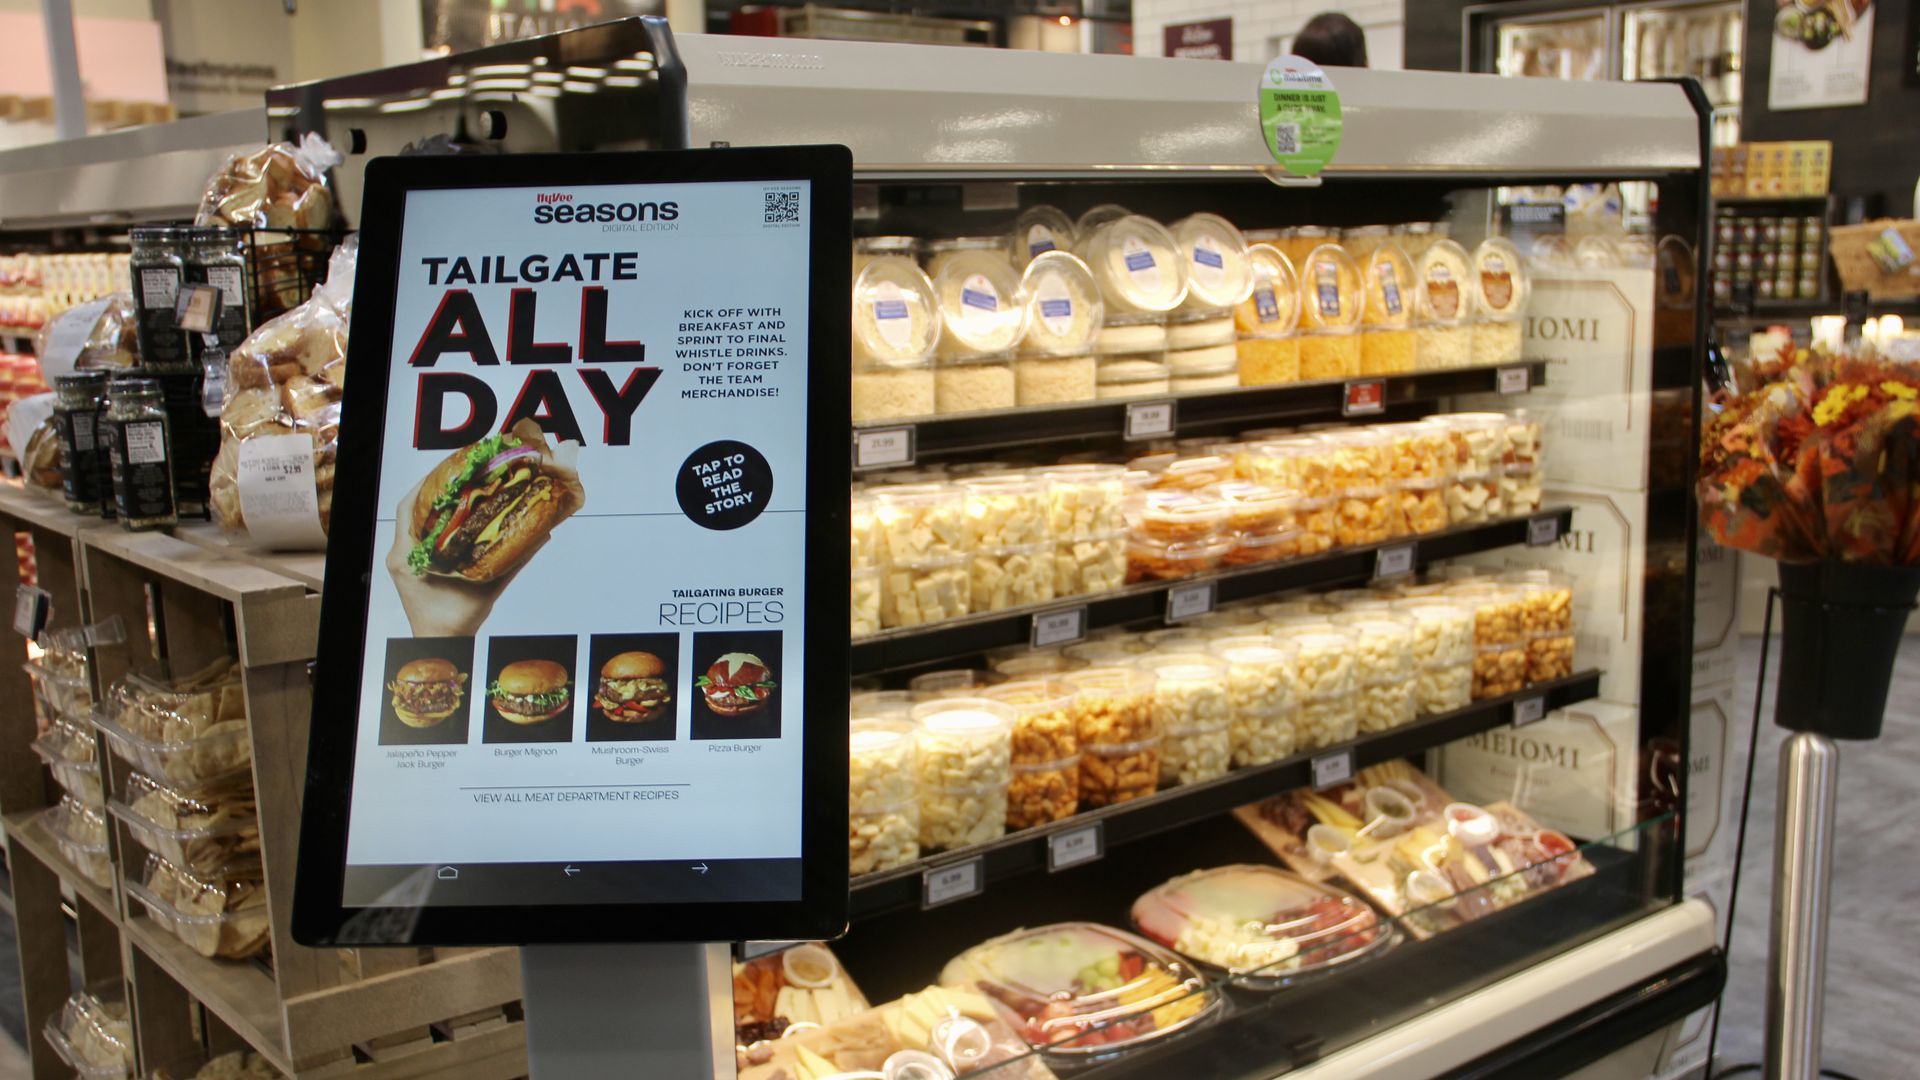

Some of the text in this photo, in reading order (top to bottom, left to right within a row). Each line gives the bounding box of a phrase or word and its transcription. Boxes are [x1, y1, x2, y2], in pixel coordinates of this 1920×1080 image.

[534, 201, 679, 224] seasons
[602, 223, 679, 233] DIGITAL EDITION
[421, 252, 638, 285] TAILGATE
[684, 308, 781, 318] KICK OFF WITH
[407, 286, 645, 367] ALL
[679, 321, 785, 332] BREAKFAST AND
[1527, 317, 1599, 341] IOMI
[678, 334, 786, 345] SPRINT TO FINAL
[676, 347, 788, 358] WHISTLE DRINKS.
[683, 361, 779, 372] DON'T FORGET
[699, 375, 763, 385] THE TEAM
[681, 388, 779, 399] MERCHANDISE!
[413, 367, 663, 450] DAY
[692, 453, 745, 476] TAP TO
[701, 468, 743, 488] READ
[711, 482, 741, 499] THE
[705, 491, 753, 514] STORY
[672, 587, 784, 598] TAILGATING BURGER
[660, 601, 784, 626] RECIPES
[426, 750, 458, 759] Pepper
[494, 747, 558, 758] Burger Mignon
[591, 746, 669, 755] Mushroom-Swiss
[708, 744, 762, 754] Pizza Burger
[1466, 731, 1580, 770] MEIOMI
[417, 760, 446, 770] Burger
[615, 757, 644, 767] Burger
[474, 790, 679, 803] VIEW ALL MEAT DEPARTMENT RECIPES
